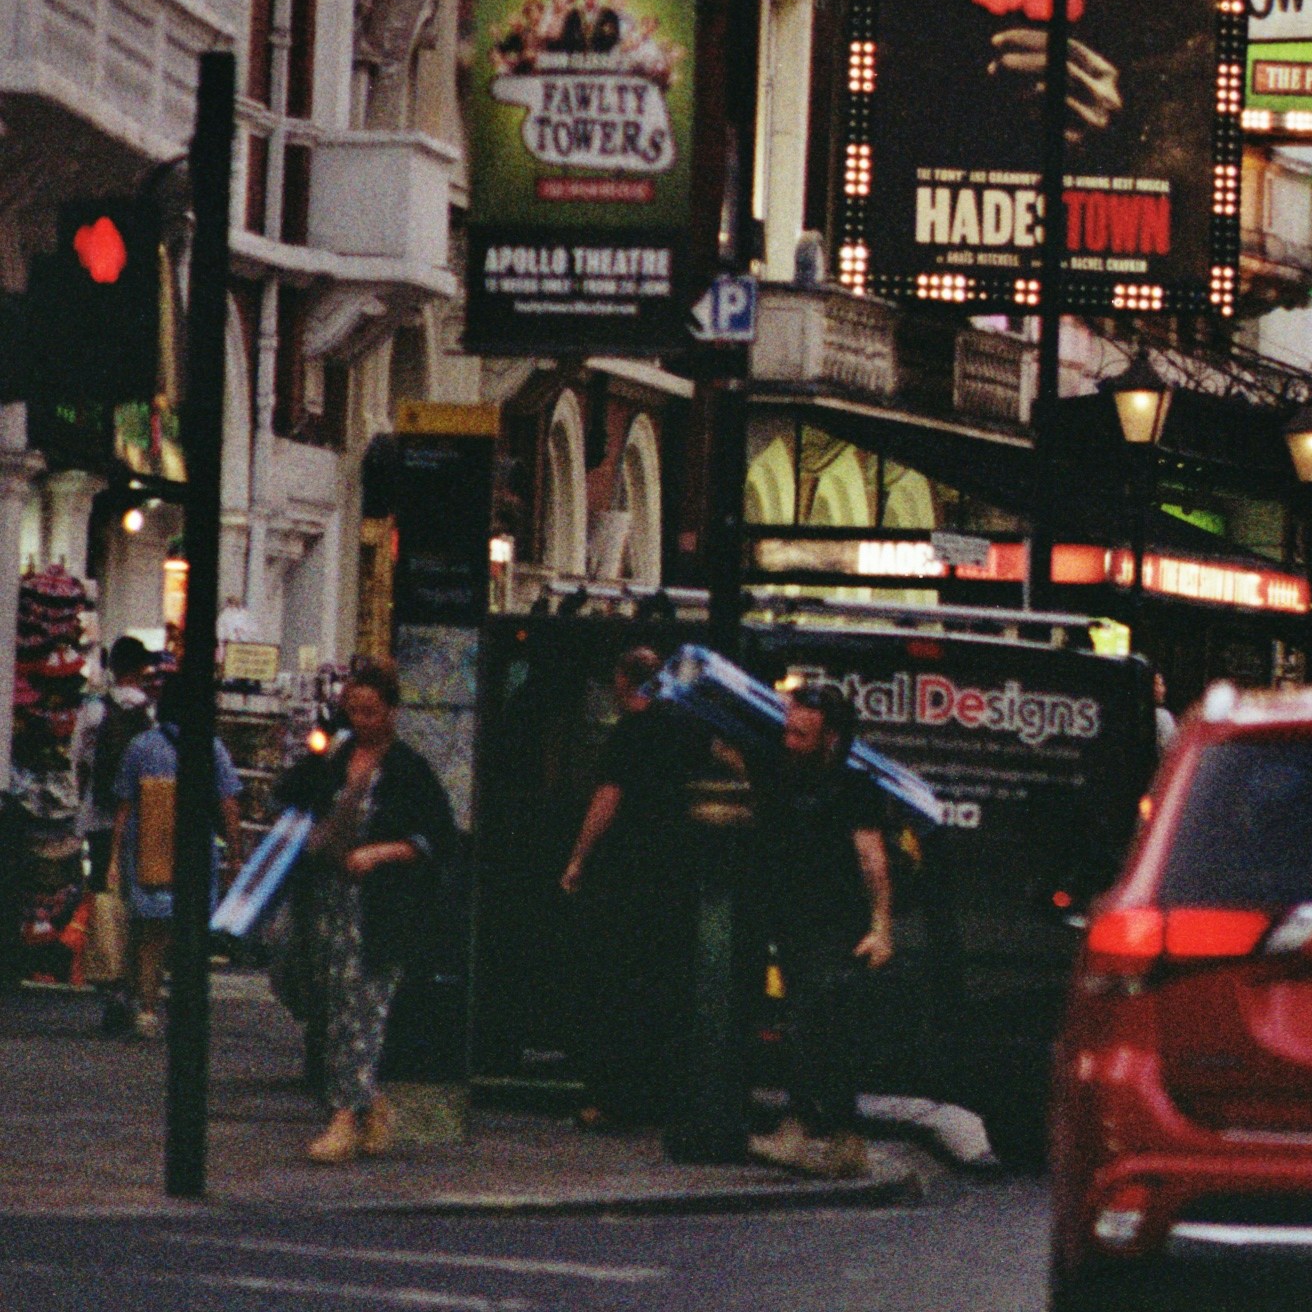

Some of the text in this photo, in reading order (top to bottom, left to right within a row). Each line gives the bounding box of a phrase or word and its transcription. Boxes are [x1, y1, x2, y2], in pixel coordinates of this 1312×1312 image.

[1266, 65, 1300, 90] THE
[543, 82, 648, 115] FAWLTY
[535, 116, 667, 163] TOWERS
[484, 246, 671, 276] APOLLO THEATRE
[719, 285, 747, 329] P
[914, 673, 1100, 745] Designs
